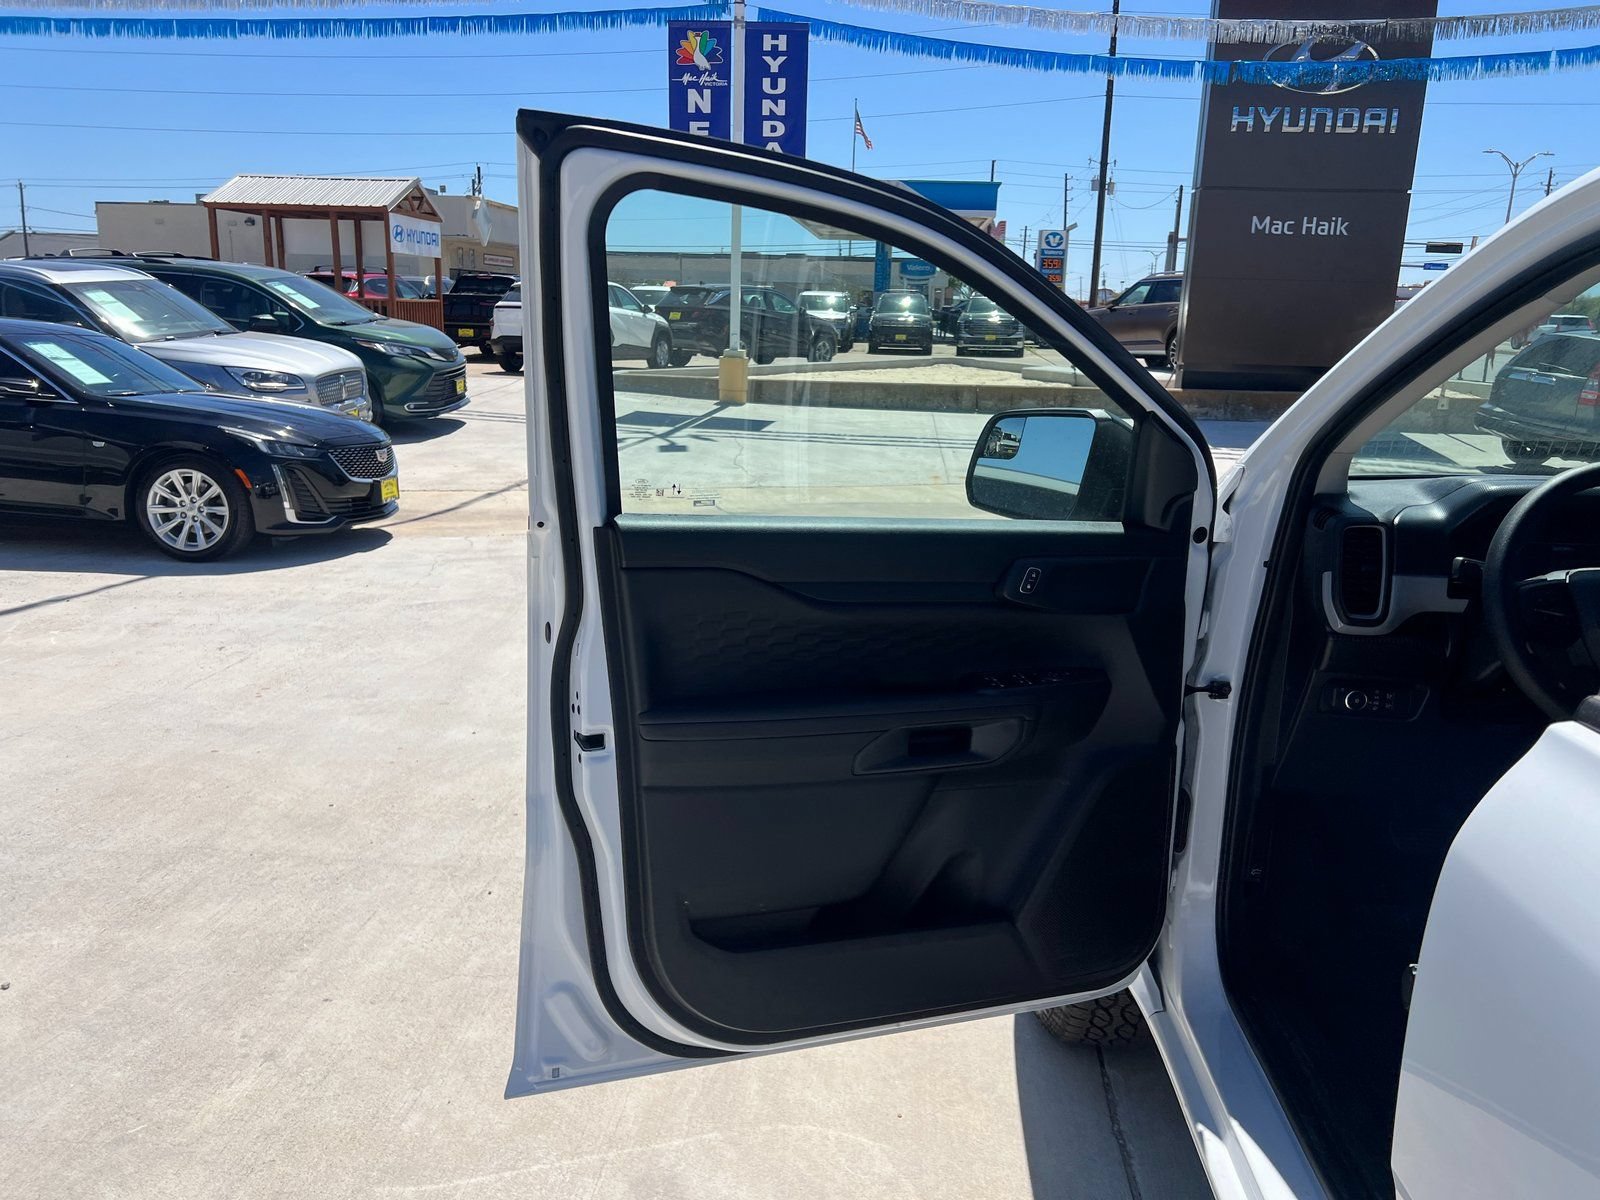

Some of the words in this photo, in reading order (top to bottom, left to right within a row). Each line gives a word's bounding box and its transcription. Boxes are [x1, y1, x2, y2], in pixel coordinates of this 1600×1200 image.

[679, 72, 698, 85] Mac
[699, 71, 721, 86] Haik
[1230, 106, 1399, 134] HYUNDAI
[1251, 216, 1295, 235] Mac
[1302, 217, 1349, 236] Haik
[406, 228, 439, 247] HYUNDAI
